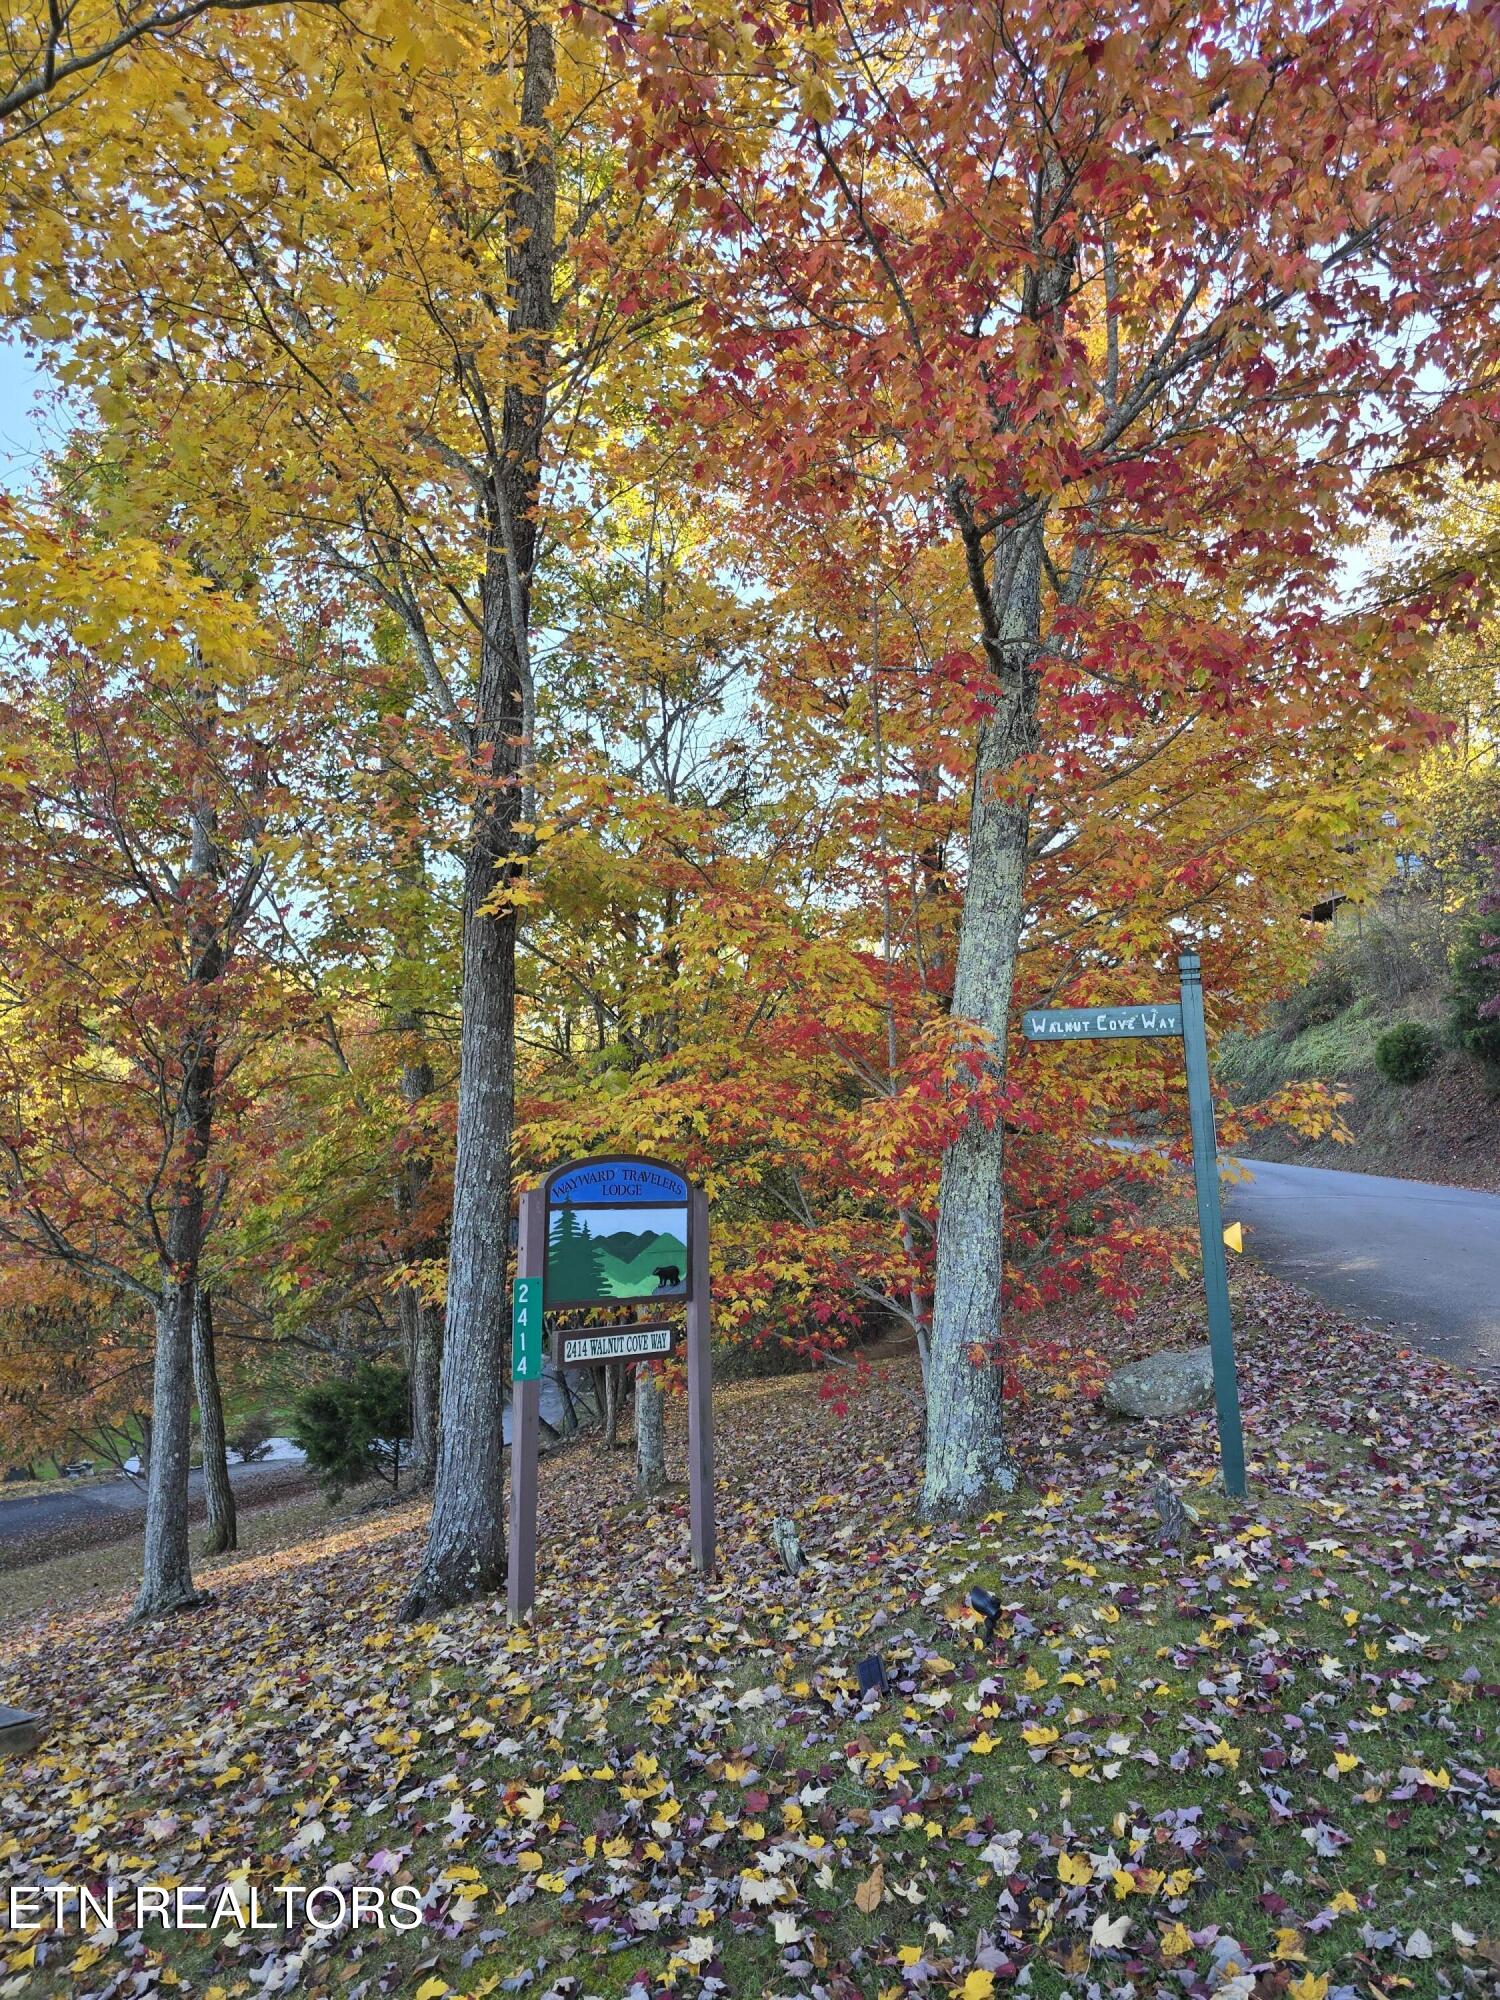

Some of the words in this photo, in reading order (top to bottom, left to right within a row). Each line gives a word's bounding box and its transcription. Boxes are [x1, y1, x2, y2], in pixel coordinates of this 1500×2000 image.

[1031, 1017, 1090, 1033] WALNUT
[1096, 1013, 1136, 1031] COVE
[1141, 1011, 1175, 1030] WAY
[552, 1169, 615, 1198] WAYWARD
[622, 1169, 682, 1195] TRAVELERS
[602, 1184, 642, 1196] LODGE
[517, 1284, 529, 1375] 2414
[566, 1340, 587, 1359] 2414
[590, 1336, 625, 1356] WALNUT
[627, 1334, 649, 1352] COVE
[650, 1332, 667, 1350] WAY
